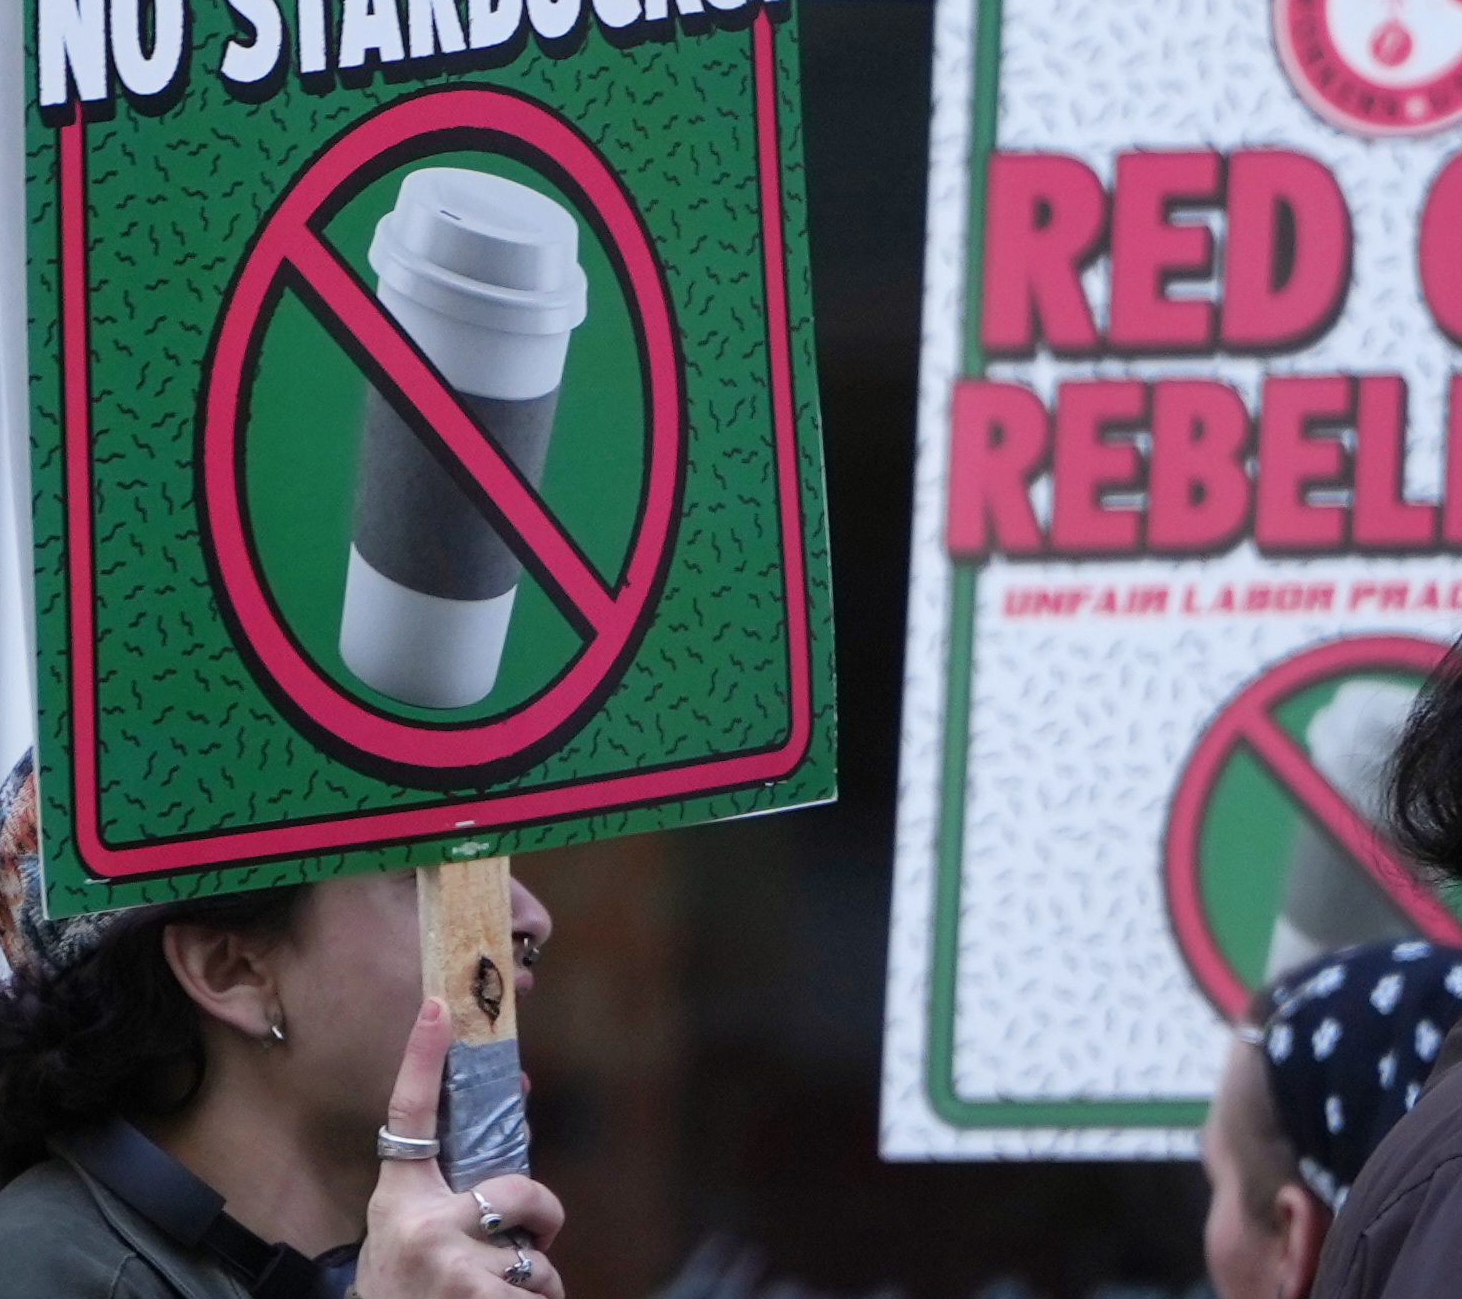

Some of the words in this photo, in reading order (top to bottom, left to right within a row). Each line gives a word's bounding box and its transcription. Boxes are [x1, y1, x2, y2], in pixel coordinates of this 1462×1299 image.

[978, 147, 1357, 357] RED
[1002, 582, 1172, 620] UNFAIR
[1179, 580, 1336, 617] LABOR
